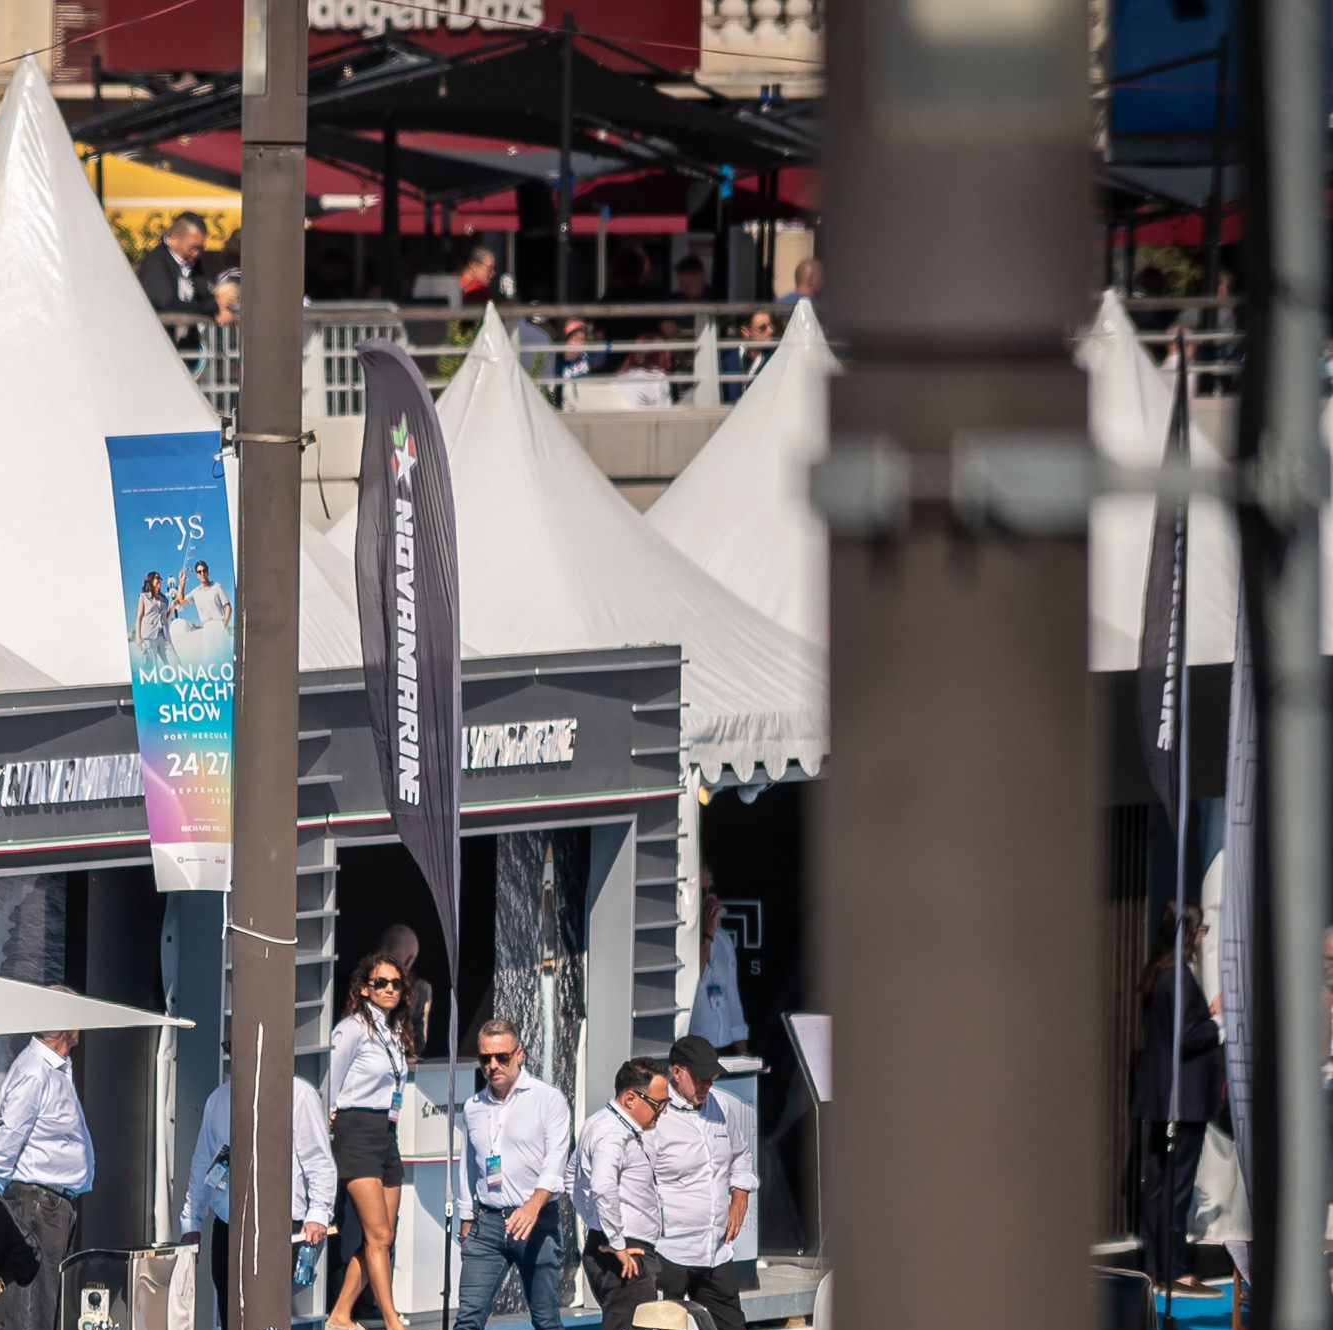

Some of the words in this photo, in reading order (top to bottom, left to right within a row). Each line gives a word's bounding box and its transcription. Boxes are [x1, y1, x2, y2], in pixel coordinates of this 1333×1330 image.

[396, 498, 420, 805] NOVAMARINE
[139, 663, 234, 684] MONACO
[174, 682, 236, 702] YACHT
[159, 703, 220, 723] SHOW
